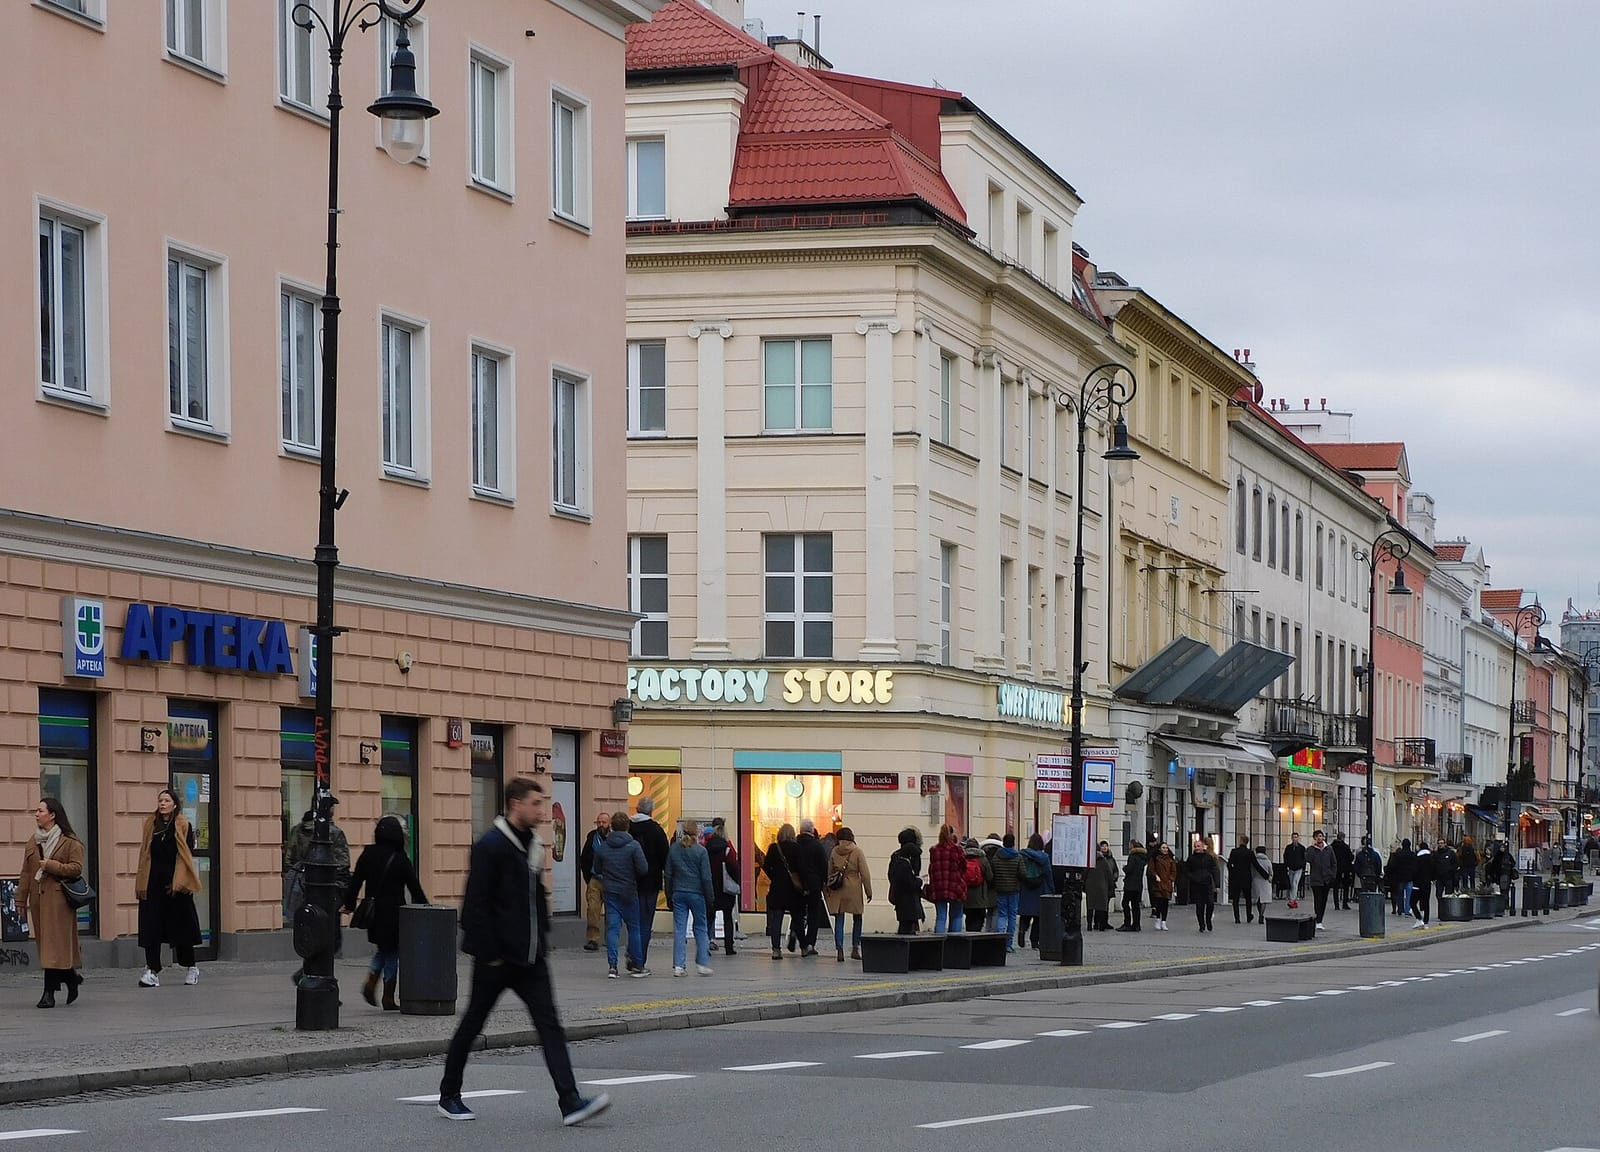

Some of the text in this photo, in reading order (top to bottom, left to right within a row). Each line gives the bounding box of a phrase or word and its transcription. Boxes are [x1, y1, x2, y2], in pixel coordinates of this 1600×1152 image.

[120, 602, 294, 674] APTEKA
[77, 659, 103, 673] APTEKA
[783, 669, 894, 705] STORE
[173, 722, 206, 738] APTEKA
[471, 739, 495, 752] PTEKA
[859, 775, 892, 785] Ordynacka
[1037, 781, 1049, 789] 222
